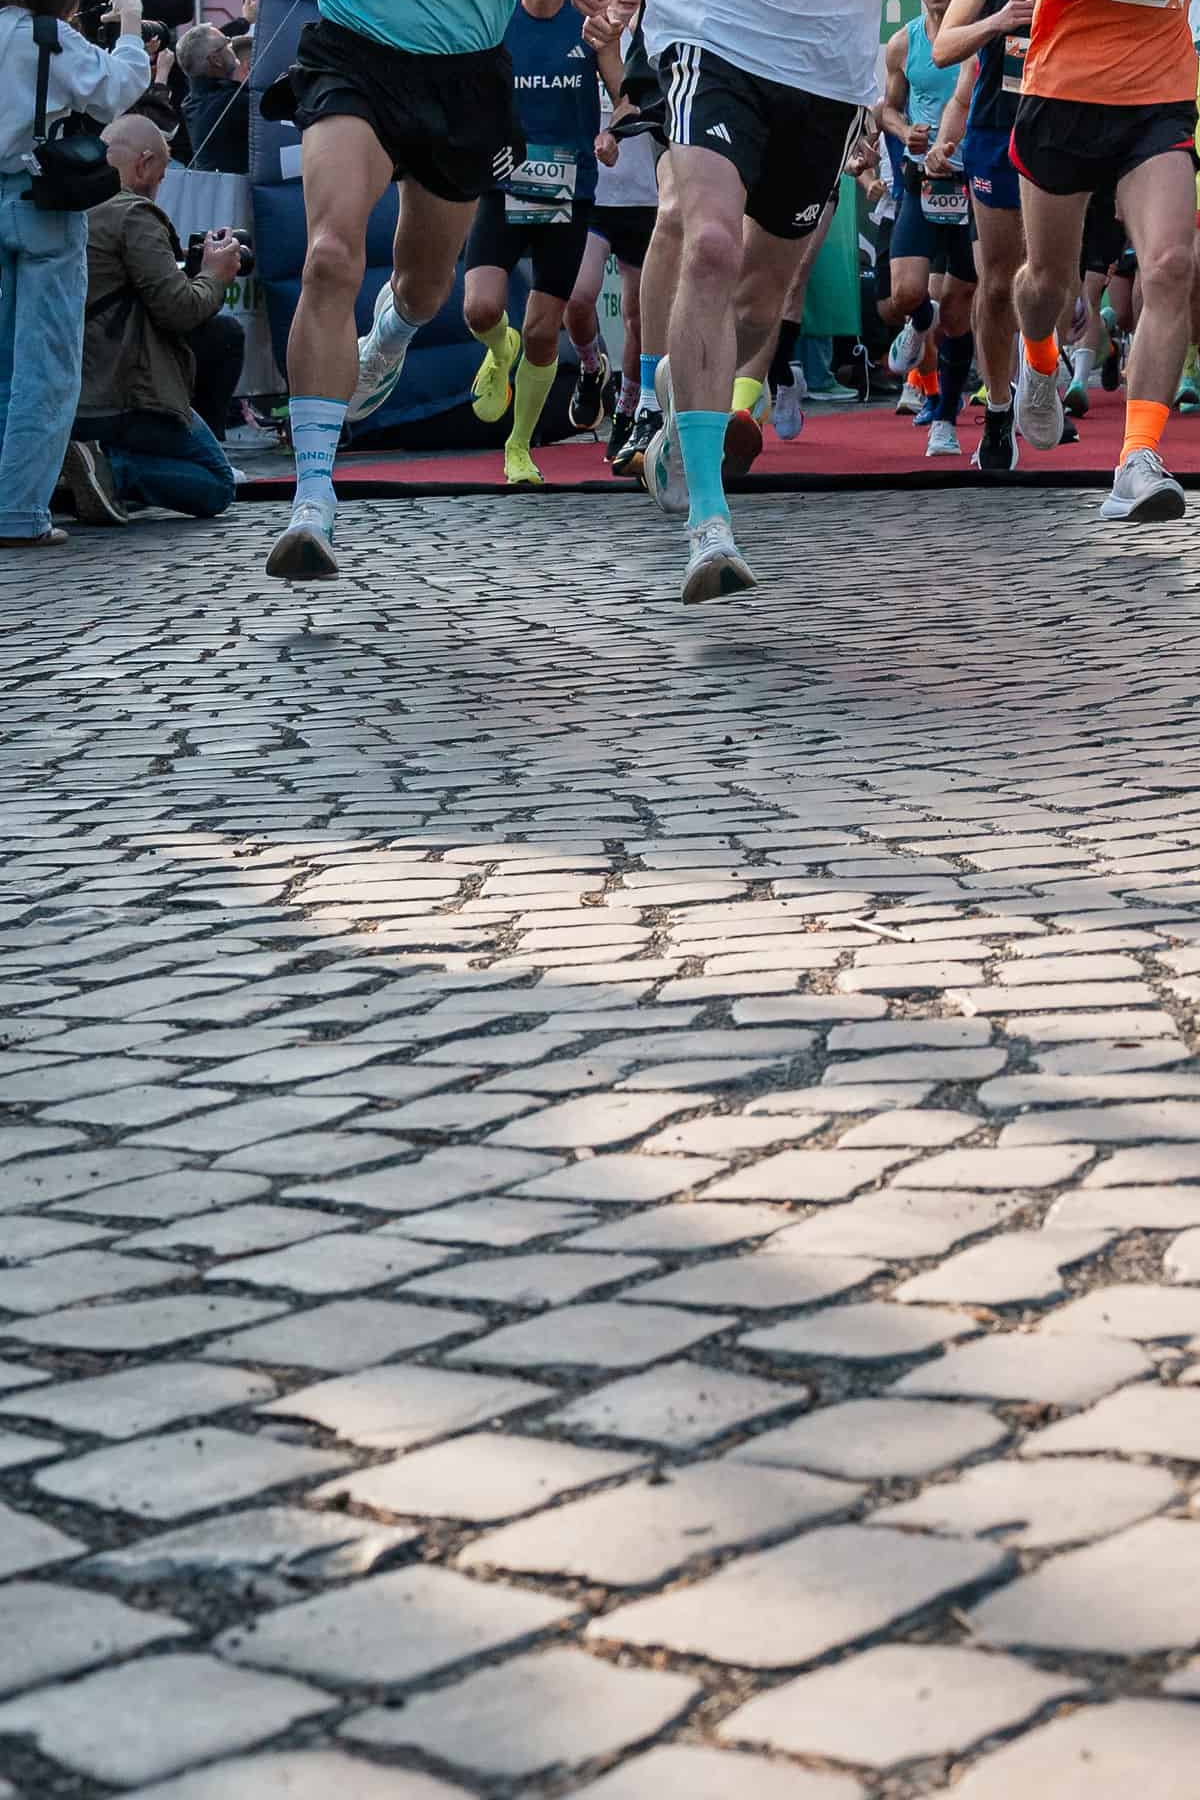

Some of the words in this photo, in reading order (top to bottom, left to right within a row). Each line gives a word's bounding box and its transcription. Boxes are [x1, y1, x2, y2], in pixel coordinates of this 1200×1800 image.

[514, 73, 584, 89] INFLAME
[522, 162, 566, 179] 4001
[927, 195, 967, 208] 4007
